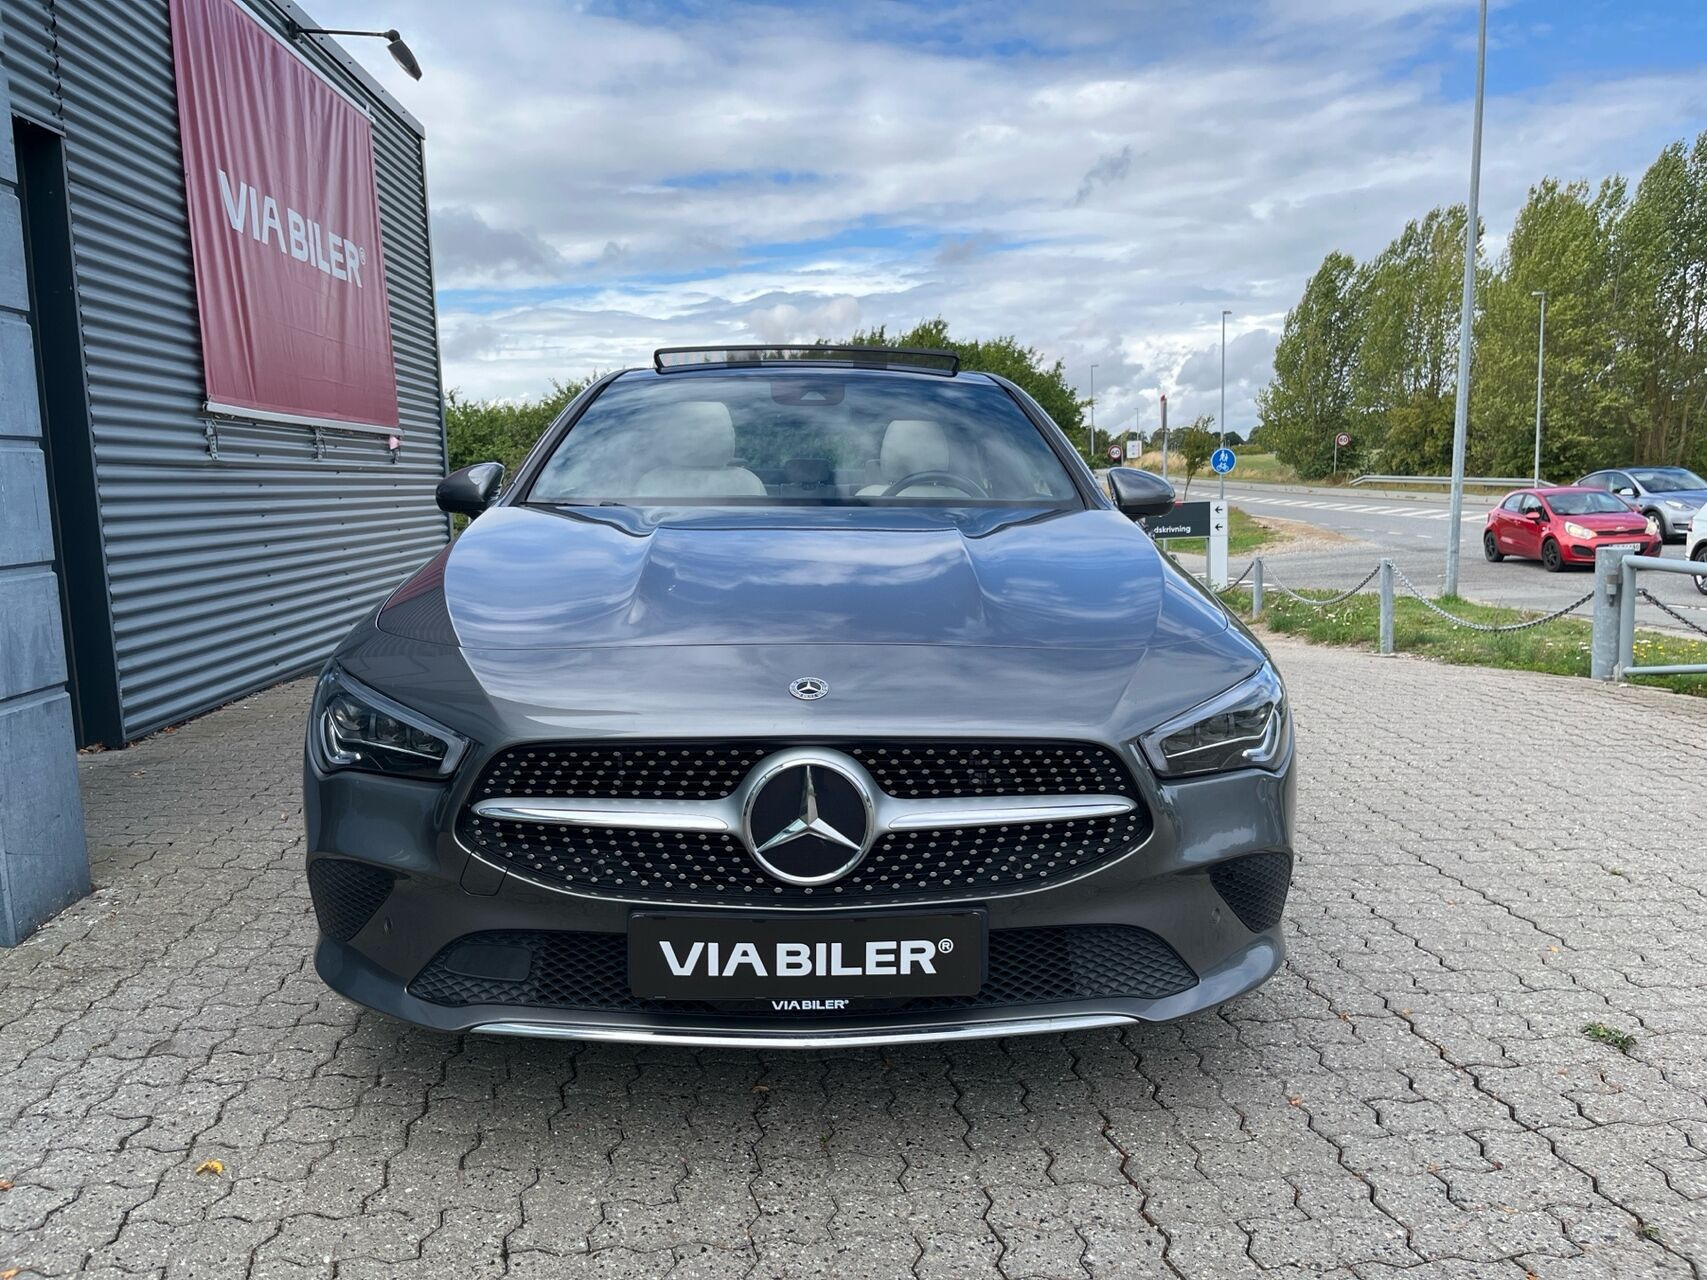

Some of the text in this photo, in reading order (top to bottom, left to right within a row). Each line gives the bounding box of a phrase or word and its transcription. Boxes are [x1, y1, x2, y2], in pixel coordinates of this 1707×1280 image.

[218, 168, 287, 254] VIA
[659, 940, 768, 977] VIA
[772, 1000, 800, 1011] VIA
